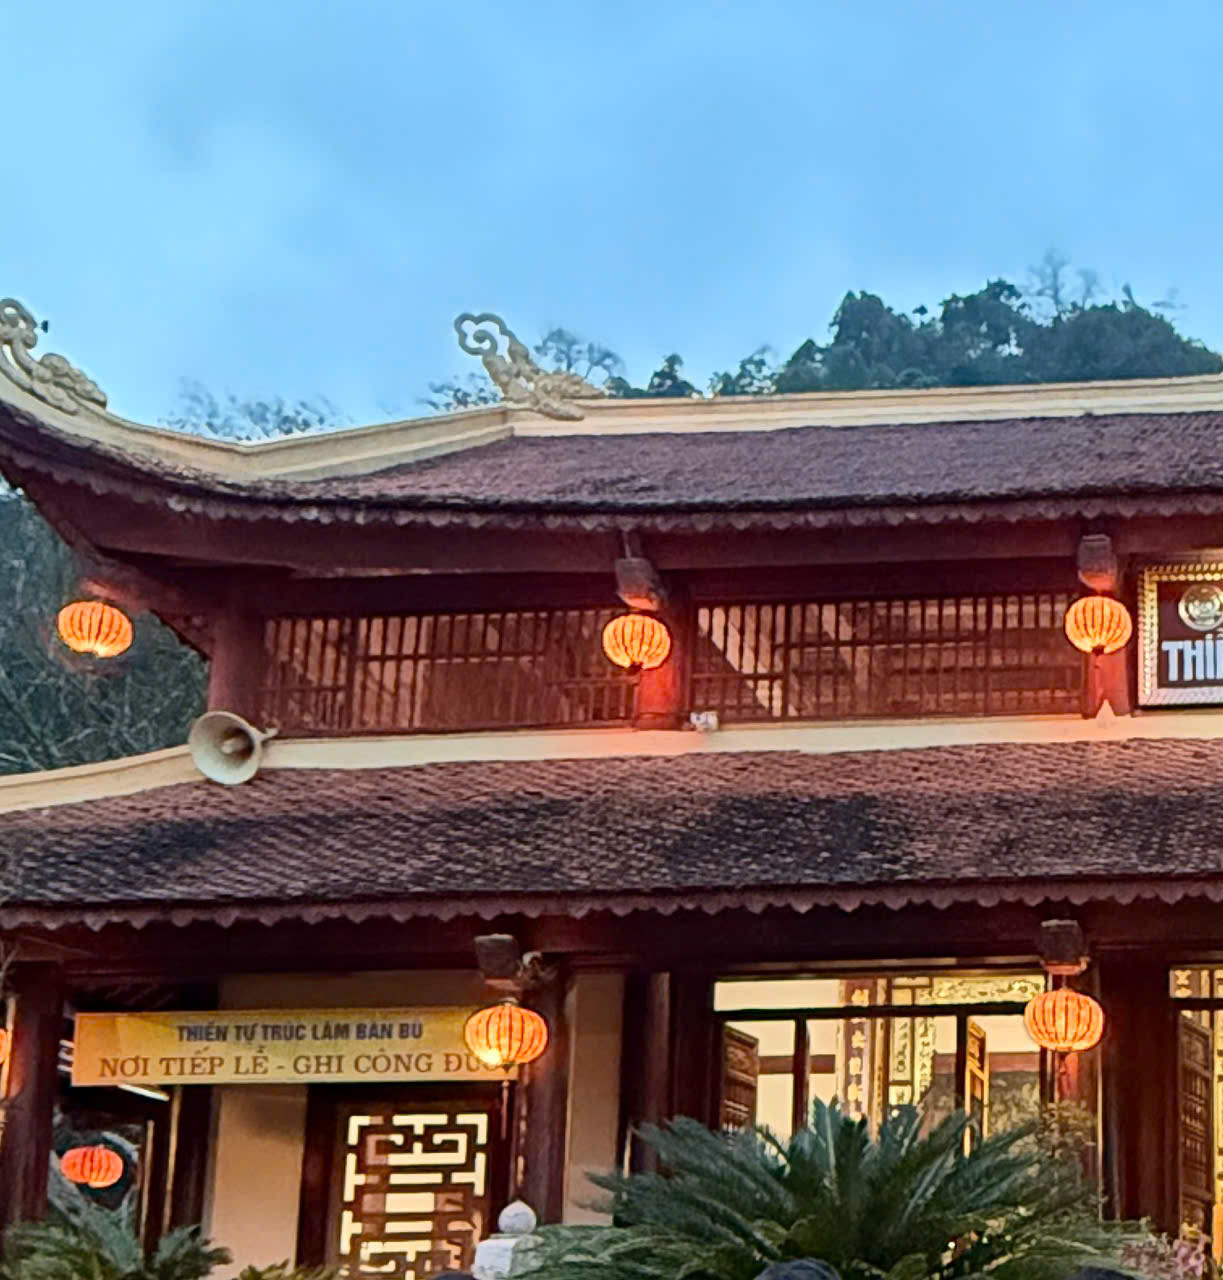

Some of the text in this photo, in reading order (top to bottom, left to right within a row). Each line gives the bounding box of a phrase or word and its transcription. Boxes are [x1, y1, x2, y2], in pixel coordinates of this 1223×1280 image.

[99, 1055, 150, 1078] NƠI
[159, 1045, 225, 1077] TIẾP
[293, 1054, 345, 1075] GHI
[353, 1048, 433, 1075] CÔNG
